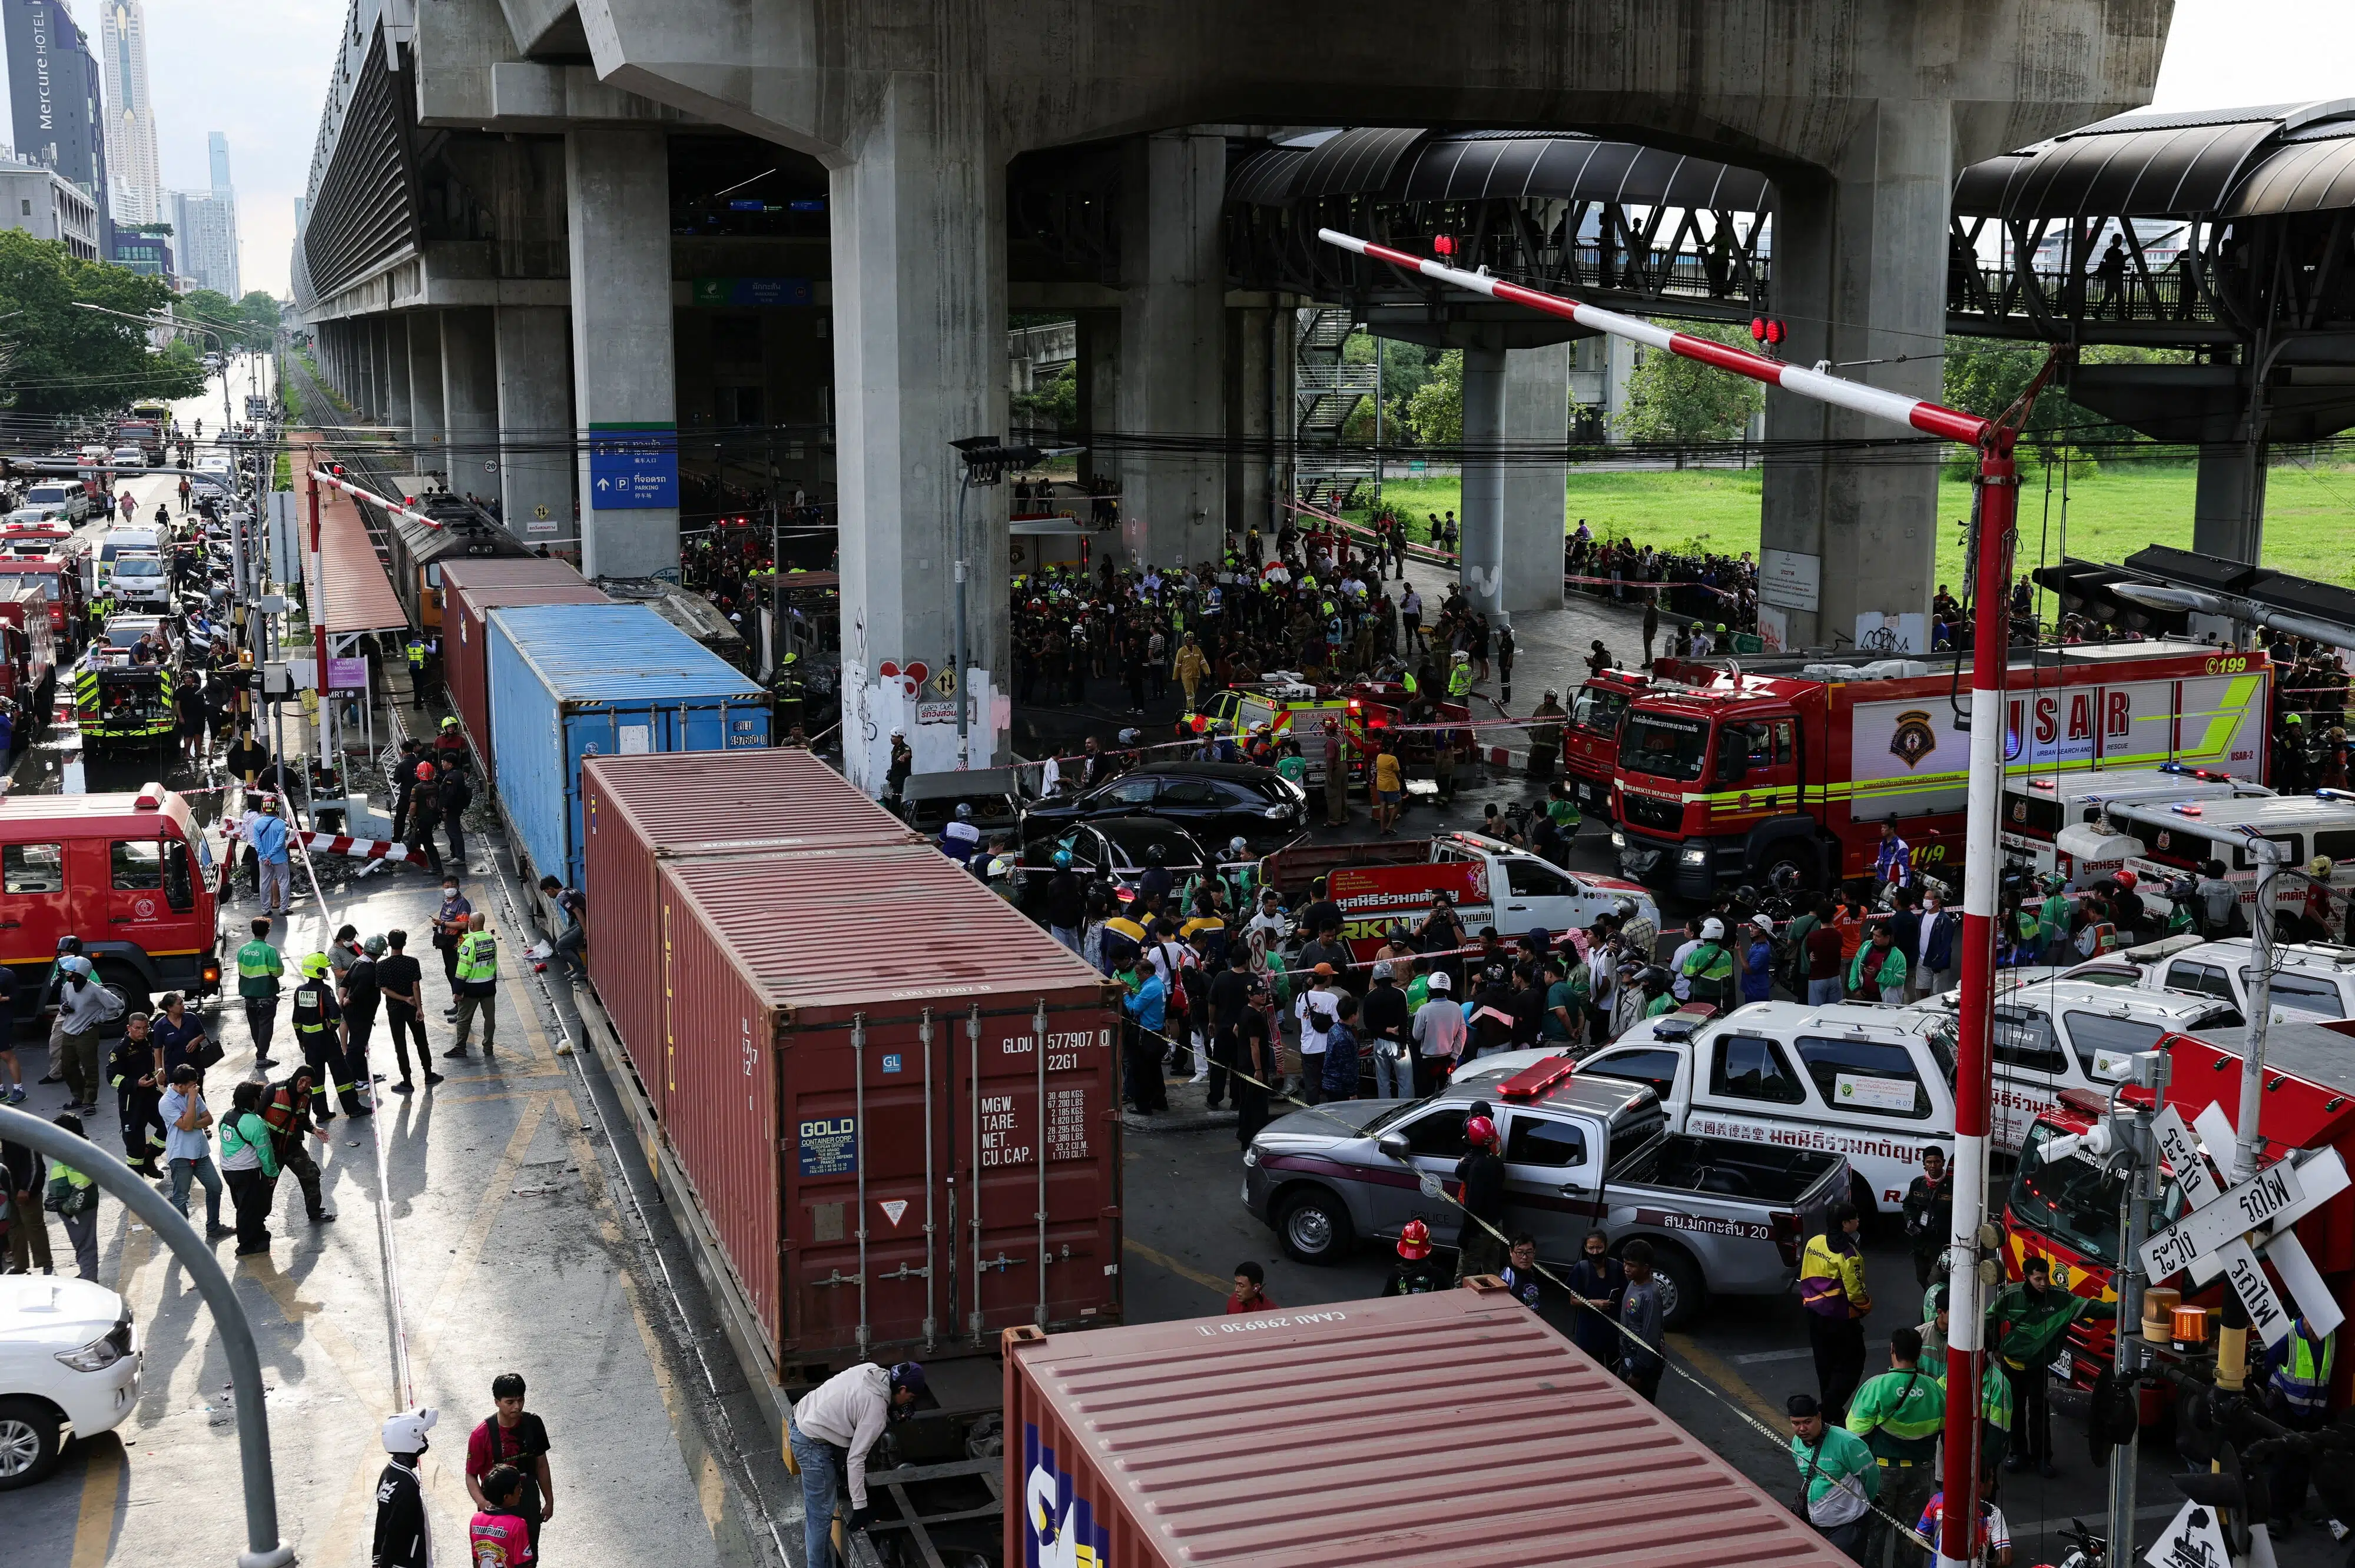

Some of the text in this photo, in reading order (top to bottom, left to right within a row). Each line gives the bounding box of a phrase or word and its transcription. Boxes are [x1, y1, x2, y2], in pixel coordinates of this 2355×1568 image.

[33, 11, 52, 129] Mercure HOTEL
[619, 480, 626, 489] P
[633, 473, 666, 483] ที่จอดรถ
[2218, 657, 2247, 673] 199
[1632, 715, 1698, 733] สำนักป้องกันและบรรเทาสาธารณภัย
[731, 734, 767, 745] 497660 0
[2036, 743, 2129, 757] URBAN SEARCH AND RESCUE
[2230, 750, 2254, 762] USAR-2
[1624, 784, 1681, 800] FIRE&RESCUE DEPARTMENT
[1336, 889, 1459, 912] มูลนิธิร่วมกตัญู
[243, 948, 260, 956] Grab
[926, 986, 973, 995] 577907
[1407, 983, 1419, 991] Grab
[300, 991, 316, 999] กทม.
[1003, 1030, 1109, 1054] GLDU 577907 0
[883, 1056, 900, 1068] GL
[1048, 1053, 1077, 1071] 22G1
[1855, 1082, 1901, 1092] สถาบันนิติเวชวิทยา
[981, 1089, 1086, 1114] MGW. 30.480 KGS.
[1047, 1098, 1083, 1109] 67.200 LBS
[982, 1107, 1086, 1131] TARE. 2.185 KGS.
[1052, 1115, 1083, 1125] 4.820 LBS
[801, 1118, 854, 1137] GOLD
[1690, 1119, 1764, 1141] 泰國義德善堂
[801, 1137, 834, 1146] CONTAINER
[982, 1124, 1086, 1149] NET. 28.295 KGS.
[1047, 1132, 1083, 1143] 62.380 LBS
[983, 1141, 1089, 1167] CU.CAP. 33.2 CU.M.
[1053, 1149, 1089, 1160] 1.173 CU.FT.
[2162, 1127, 2201, 1195] ระวัง
[1664, 1214, 1769, 1240] สน.มักกะสัน 20
[2152, 1168, 2291, 1275] ระวัง รถไฟ
[2231, 1257, 2280, 1330] รถไฟ
[1220, 1317, 1291, 1333] 298930
[1295, 1311, 1346, 1325] CAAU
[1896, 1386, 1925, 1398] Gab
